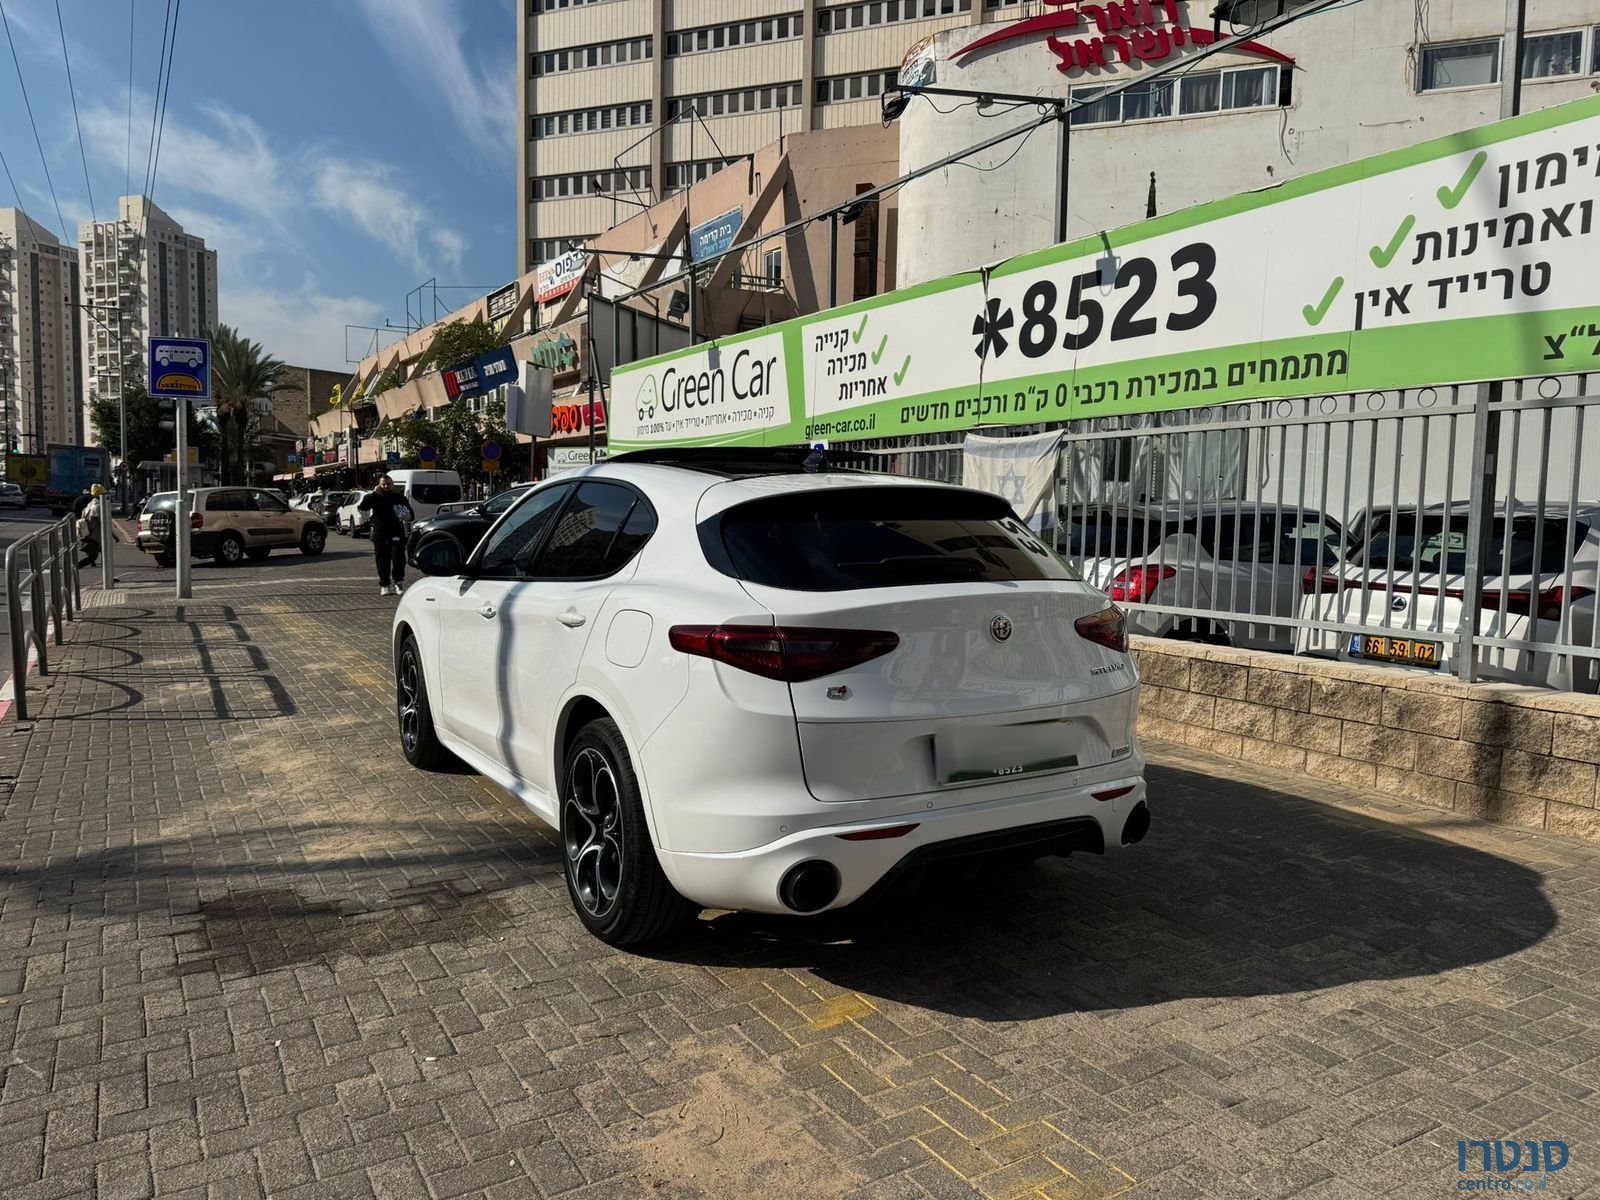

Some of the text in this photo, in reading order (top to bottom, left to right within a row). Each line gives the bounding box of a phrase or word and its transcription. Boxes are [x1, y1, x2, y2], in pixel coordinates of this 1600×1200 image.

[1498, 142, 1600, 209] ימון
[1412, 199, 1594, 265] ואמינות
[1354, 261, 1552, 331] טרייד אין
[815, 328, 850, 352] קנייה
[827, 352, 867, 376] מכירה
[1228, 349, 1348, 387] מתמחים
[661, 349, 777, 412] Green Car
[838, 375, 888, 401] אחריות
[1074, 380, 1119, 406] רכבי
[1126, 366, 1218, 399] במכירת
[731, 409, 753, 423] מכירה
[900, 402, 950, 425] חדשים
[954, 395, 1008, 419] ורכבים
[805, 412, 876, 440] green-car.co.il
